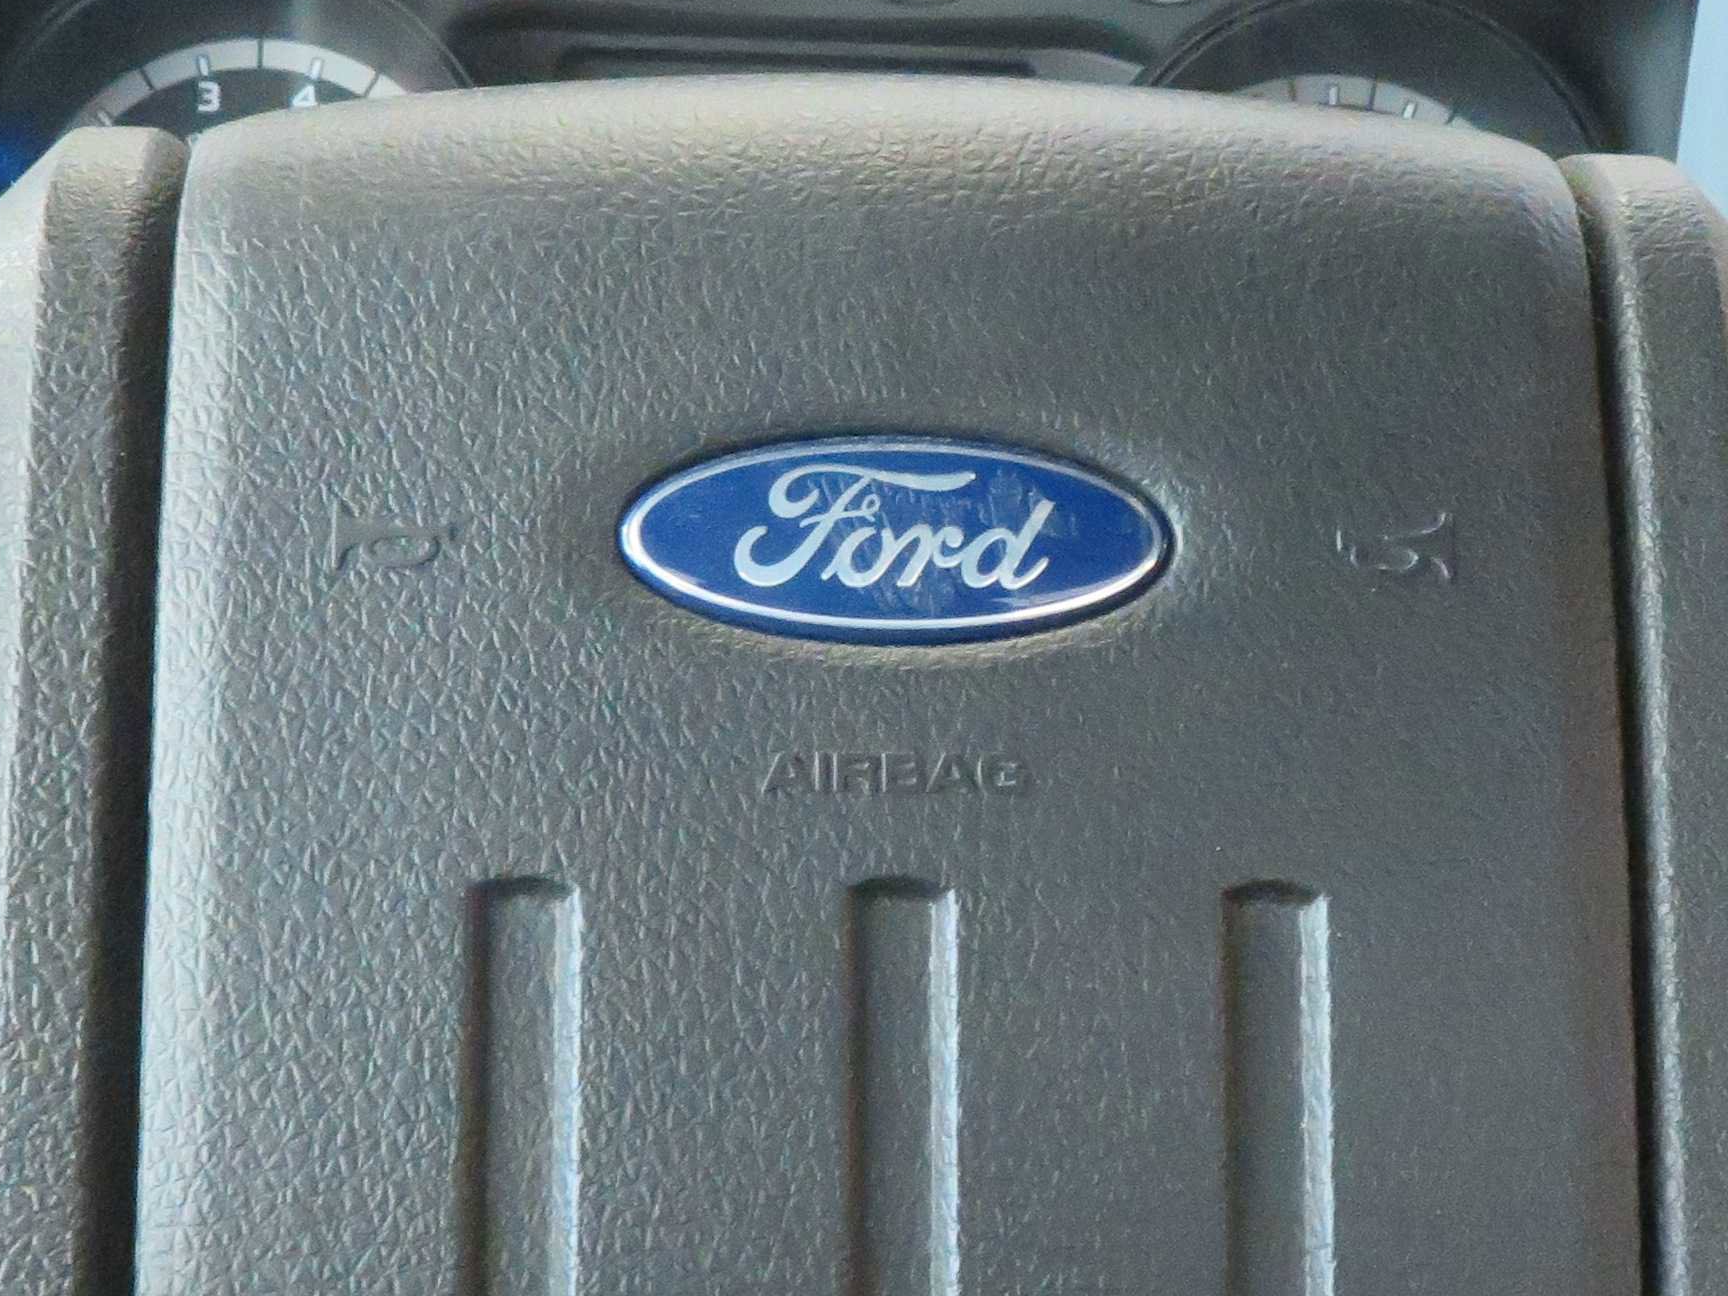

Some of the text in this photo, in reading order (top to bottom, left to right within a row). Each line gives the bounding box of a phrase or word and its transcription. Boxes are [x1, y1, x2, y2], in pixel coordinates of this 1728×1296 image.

[197, 81, 221, 112] 3
[289, 83, 318, 108] 4
[734, 463, 1056, 591] Ford
[759, 750, 1030, 794] AIRBAG
